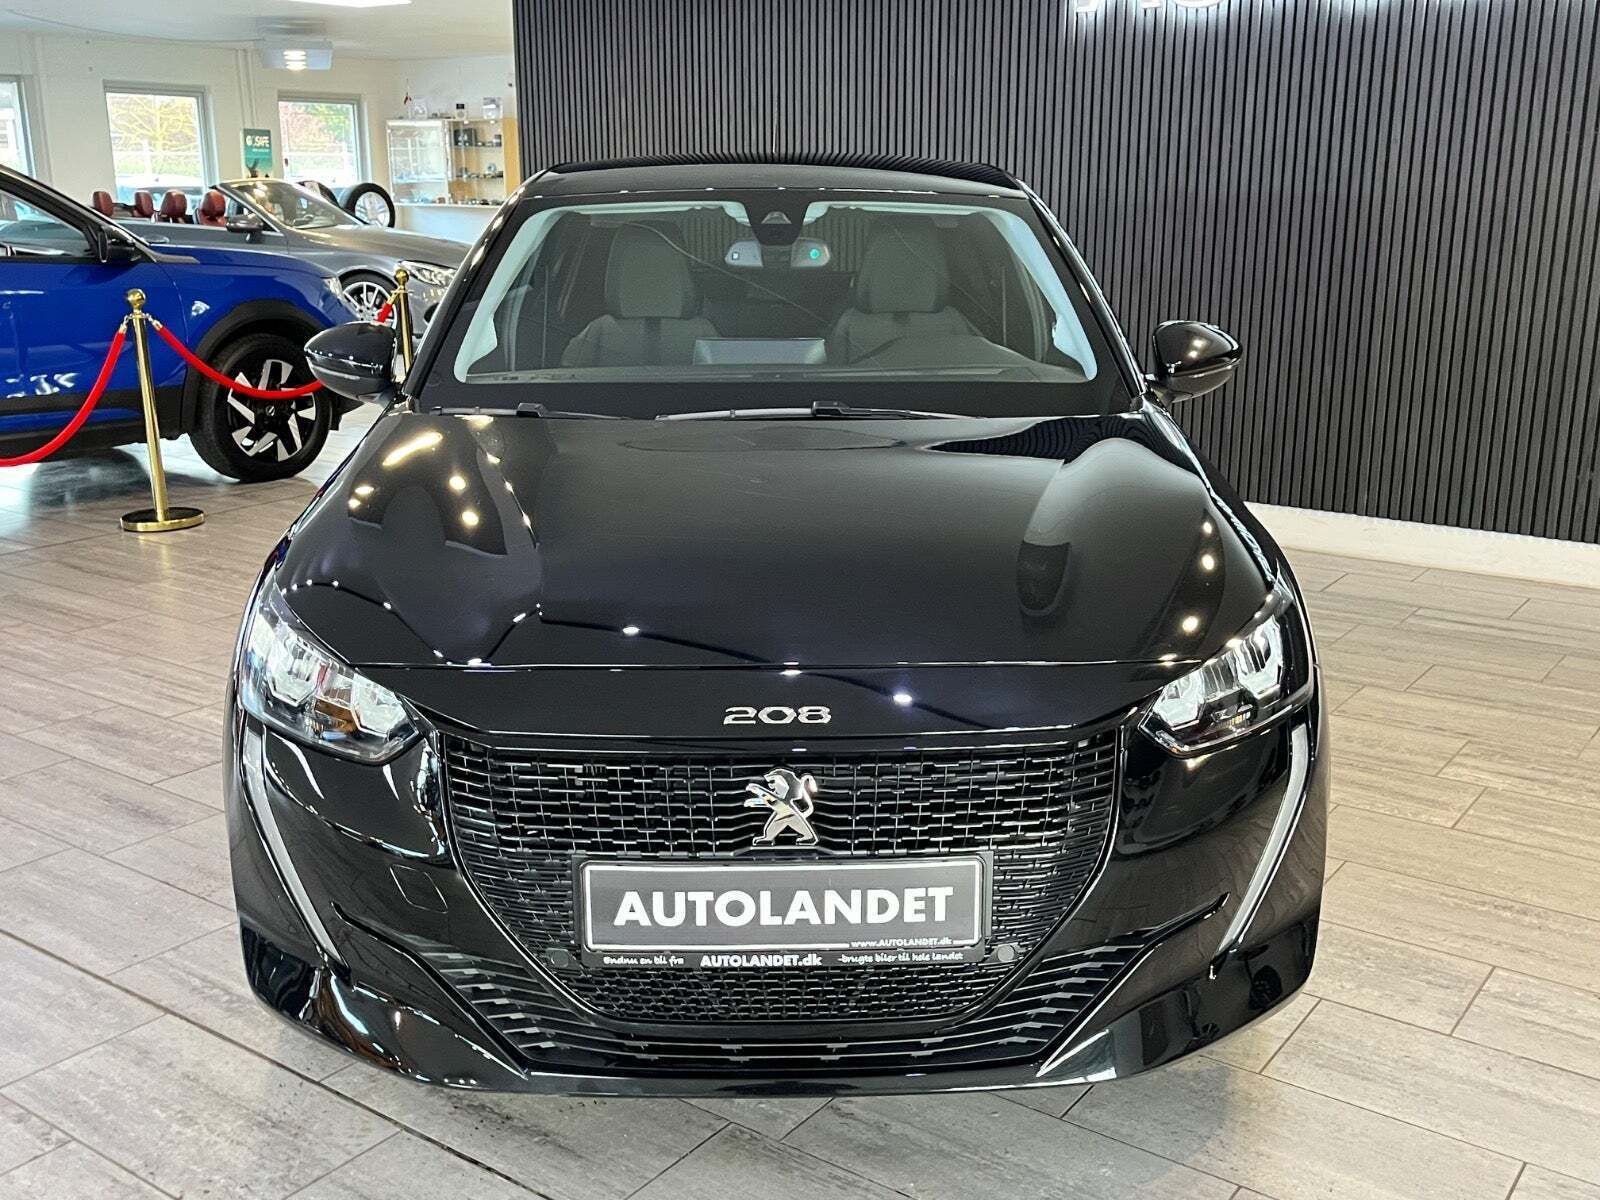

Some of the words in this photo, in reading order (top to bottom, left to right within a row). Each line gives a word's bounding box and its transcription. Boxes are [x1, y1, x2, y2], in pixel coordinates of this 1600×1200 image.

[723, 705, 832, 725] 208
[614, 887, 954, 927] AUTOLANDET
[851, 936, 953, 948] www.AUTOLANDET.dk
[639, 957, 653, 965] en
[700, 954, 823, 967] AUTOLANDET.dk
[875, 952, 897, 963] biler
[898, 952, 911, 962] til
[912, 951, 931, 962] hele
[932, 951, 964, 961] landet
